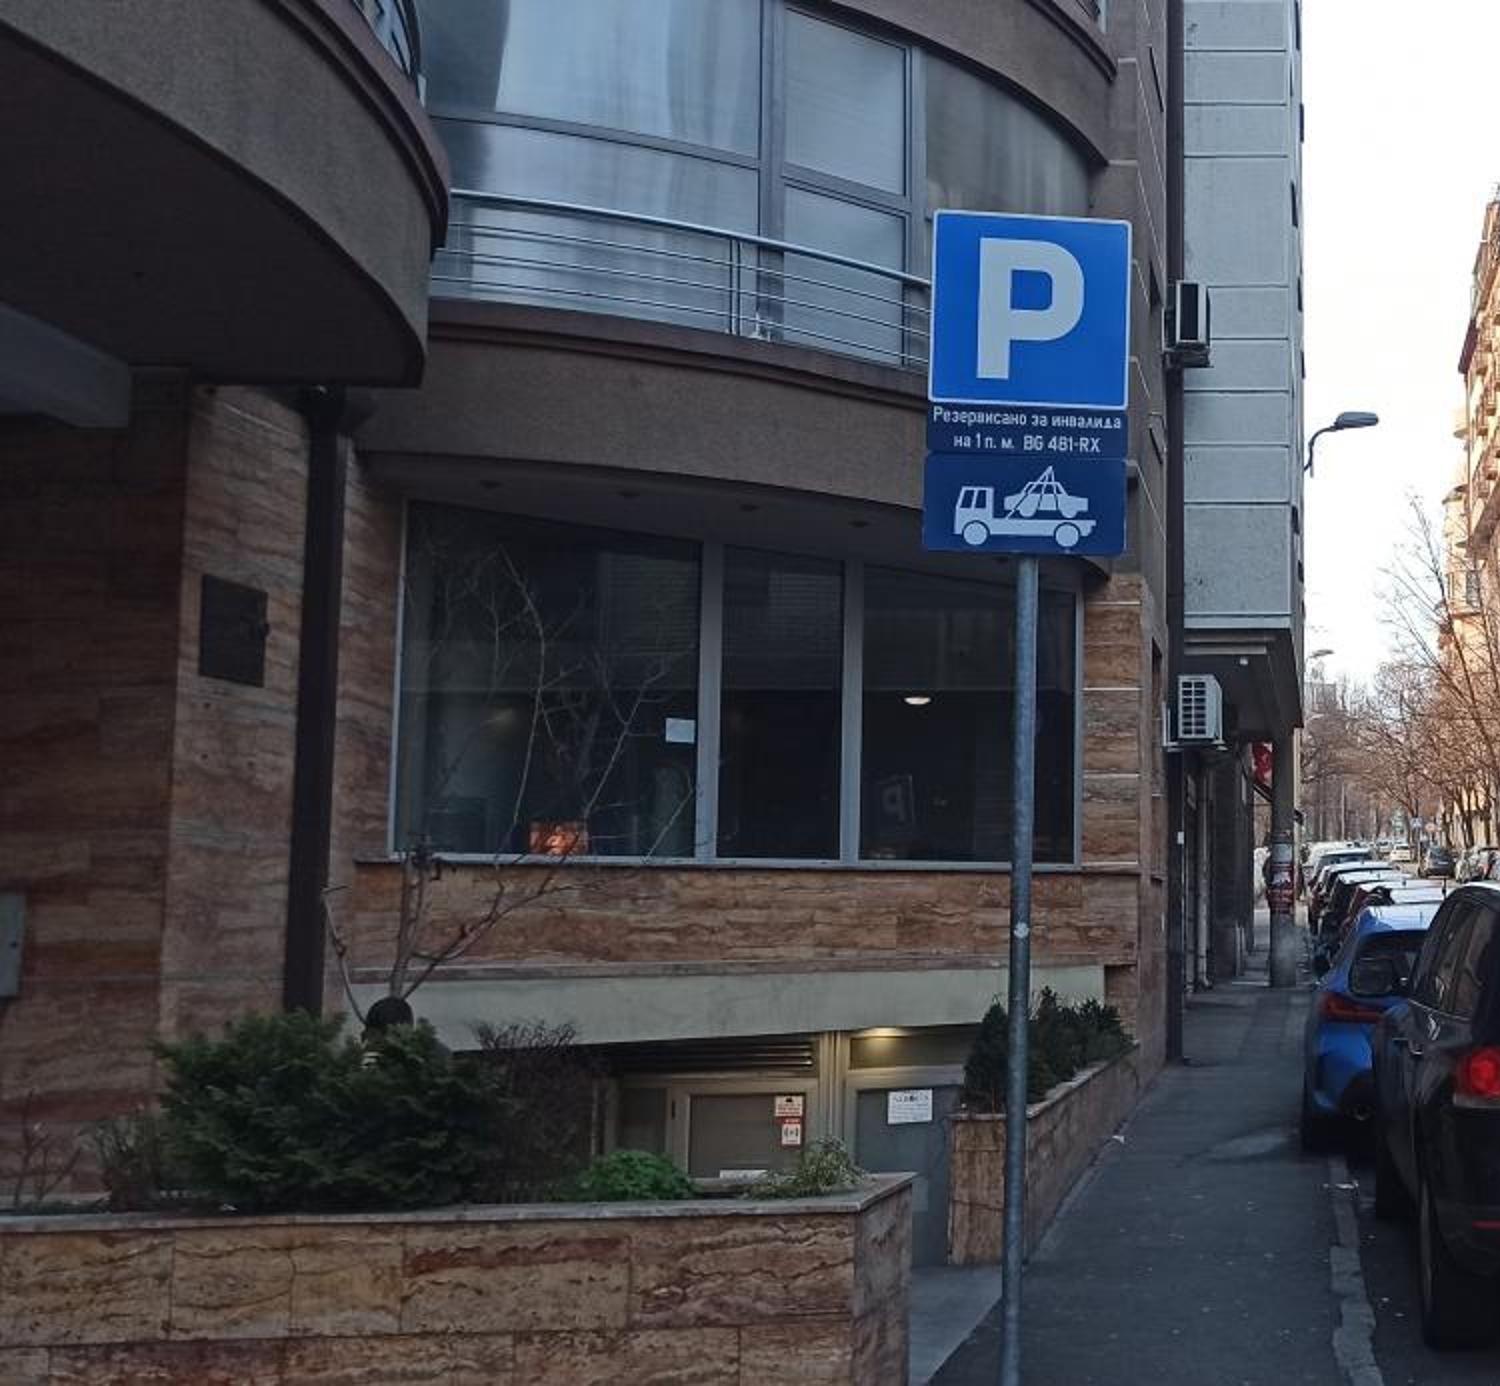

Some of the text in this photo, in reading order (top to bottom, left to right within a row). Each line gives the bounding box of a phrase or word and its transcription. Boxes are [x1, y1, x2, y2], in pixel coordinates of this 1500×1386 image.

[976, 237, 1085, 379] P
[933, 406, 1121, 429] Резервисано за инвалида
[953, 435, 971, 448] на
[1023, 435, 1043, 450] BG
[1047, 435, 1101, 452] 481-RX
